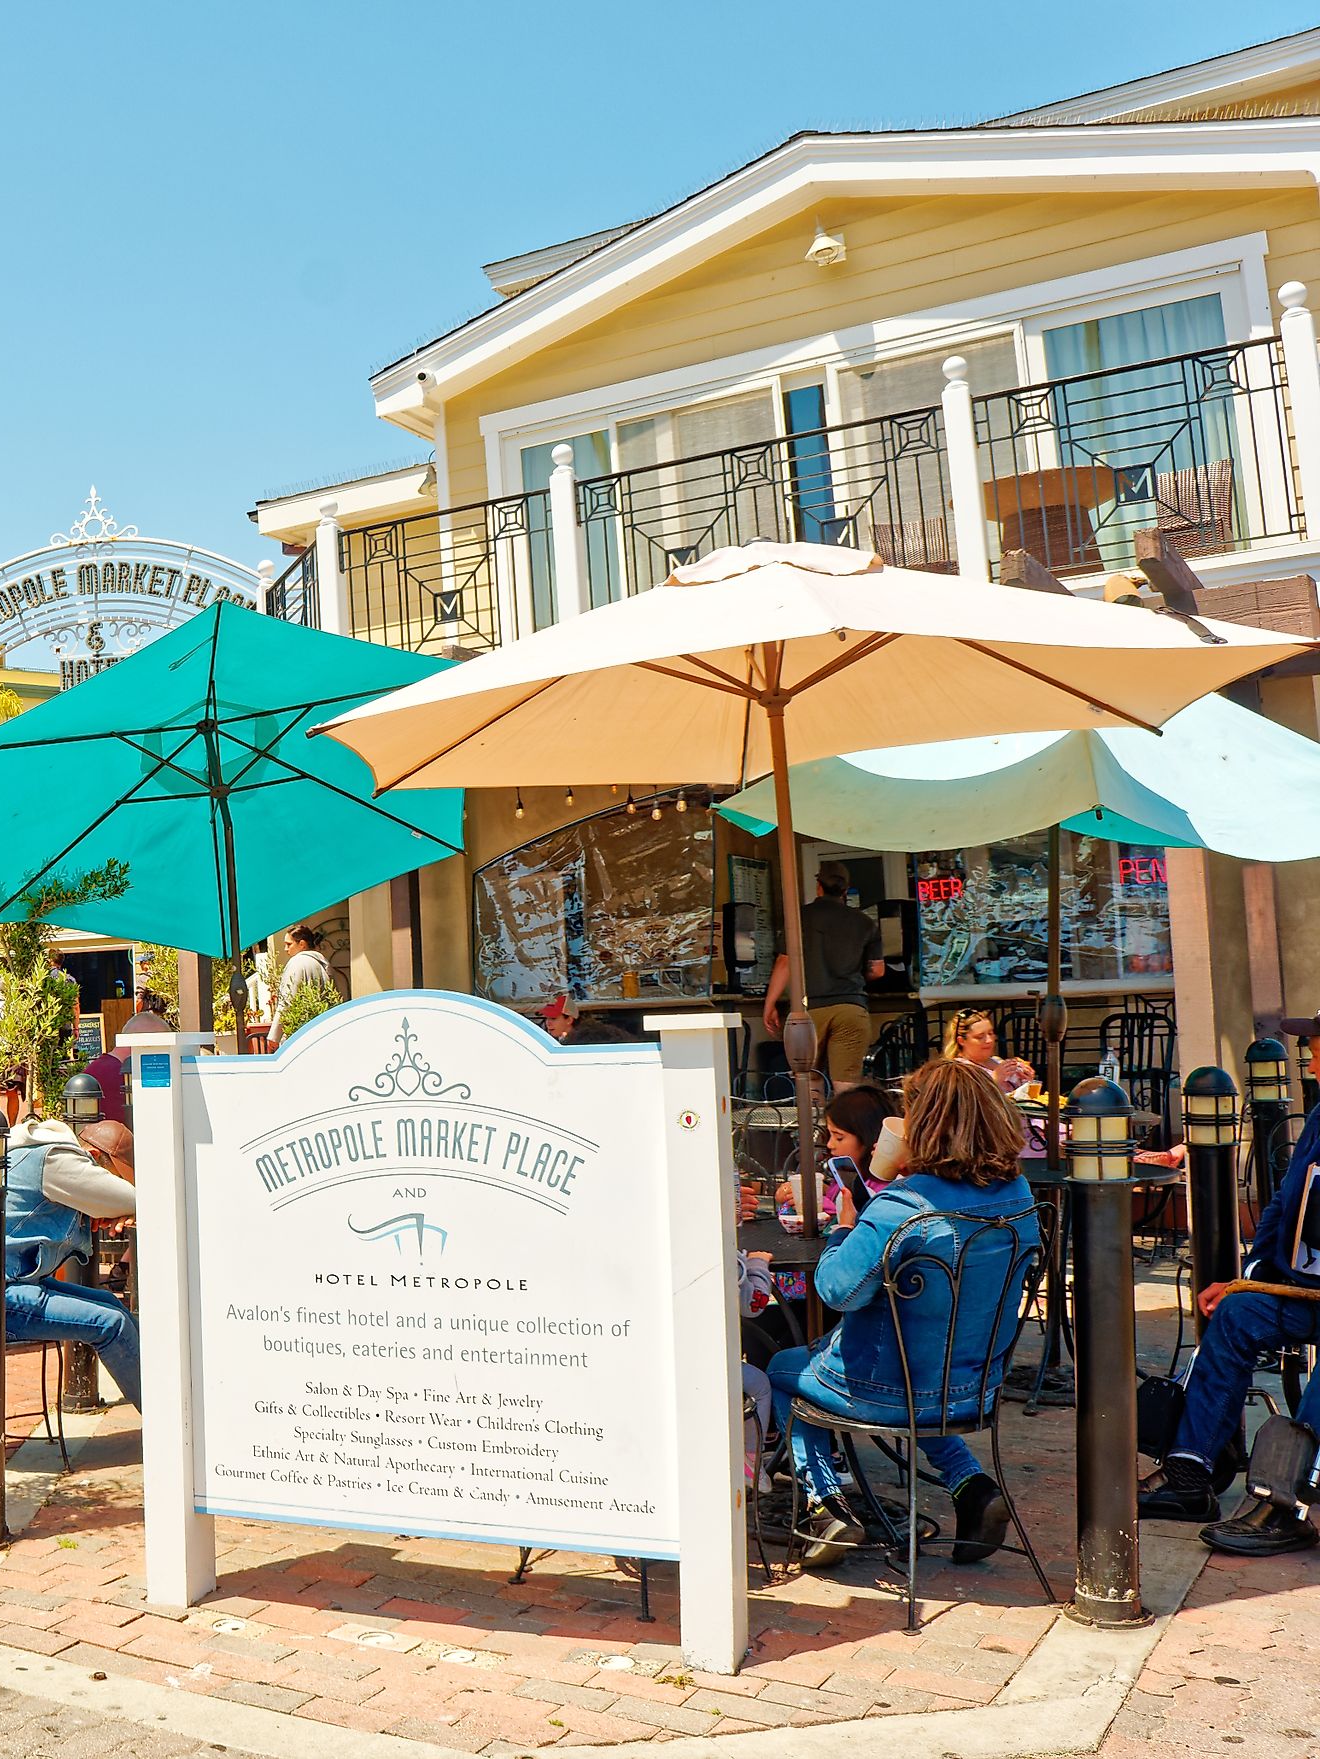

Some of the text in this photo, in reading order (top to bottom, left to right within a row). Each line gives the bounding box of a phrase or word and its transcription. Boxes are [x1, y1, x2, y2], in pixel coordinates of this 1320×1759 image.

[77, 561, 180, 600] MARKET
[917, 878, 963, 901] BEER
[255, 1117, 586, 1197] METROPOLE MARKET PLACE
[393, 1188, 426, 1198] AND
[316, 1274, 527, 1291] HOTEL METROPOLE
[227, 1304, 630, 1336] Avalon's finest hotel and a unique collection of
[264, 1335, 587, 1368] boutiques, eateries and entertainment
[305, 1382, 544, 1413] Salon & Day Spa Fine Art & Jewelry
[254, 1401, 604, 1442] Gifts & Collectibles Resort Wear Children's Clothing
[293, 1426, 559, 1462] Specialty Sunglasses Custom Embroidery
[253, 1445, 609, 1486] Ethnic Art & Natural Apothecary International Cuisine
[214, 1464, 656, 1514] Gourmet Coffee & Pastries Ice Cream & Candy Amusement Arcade
